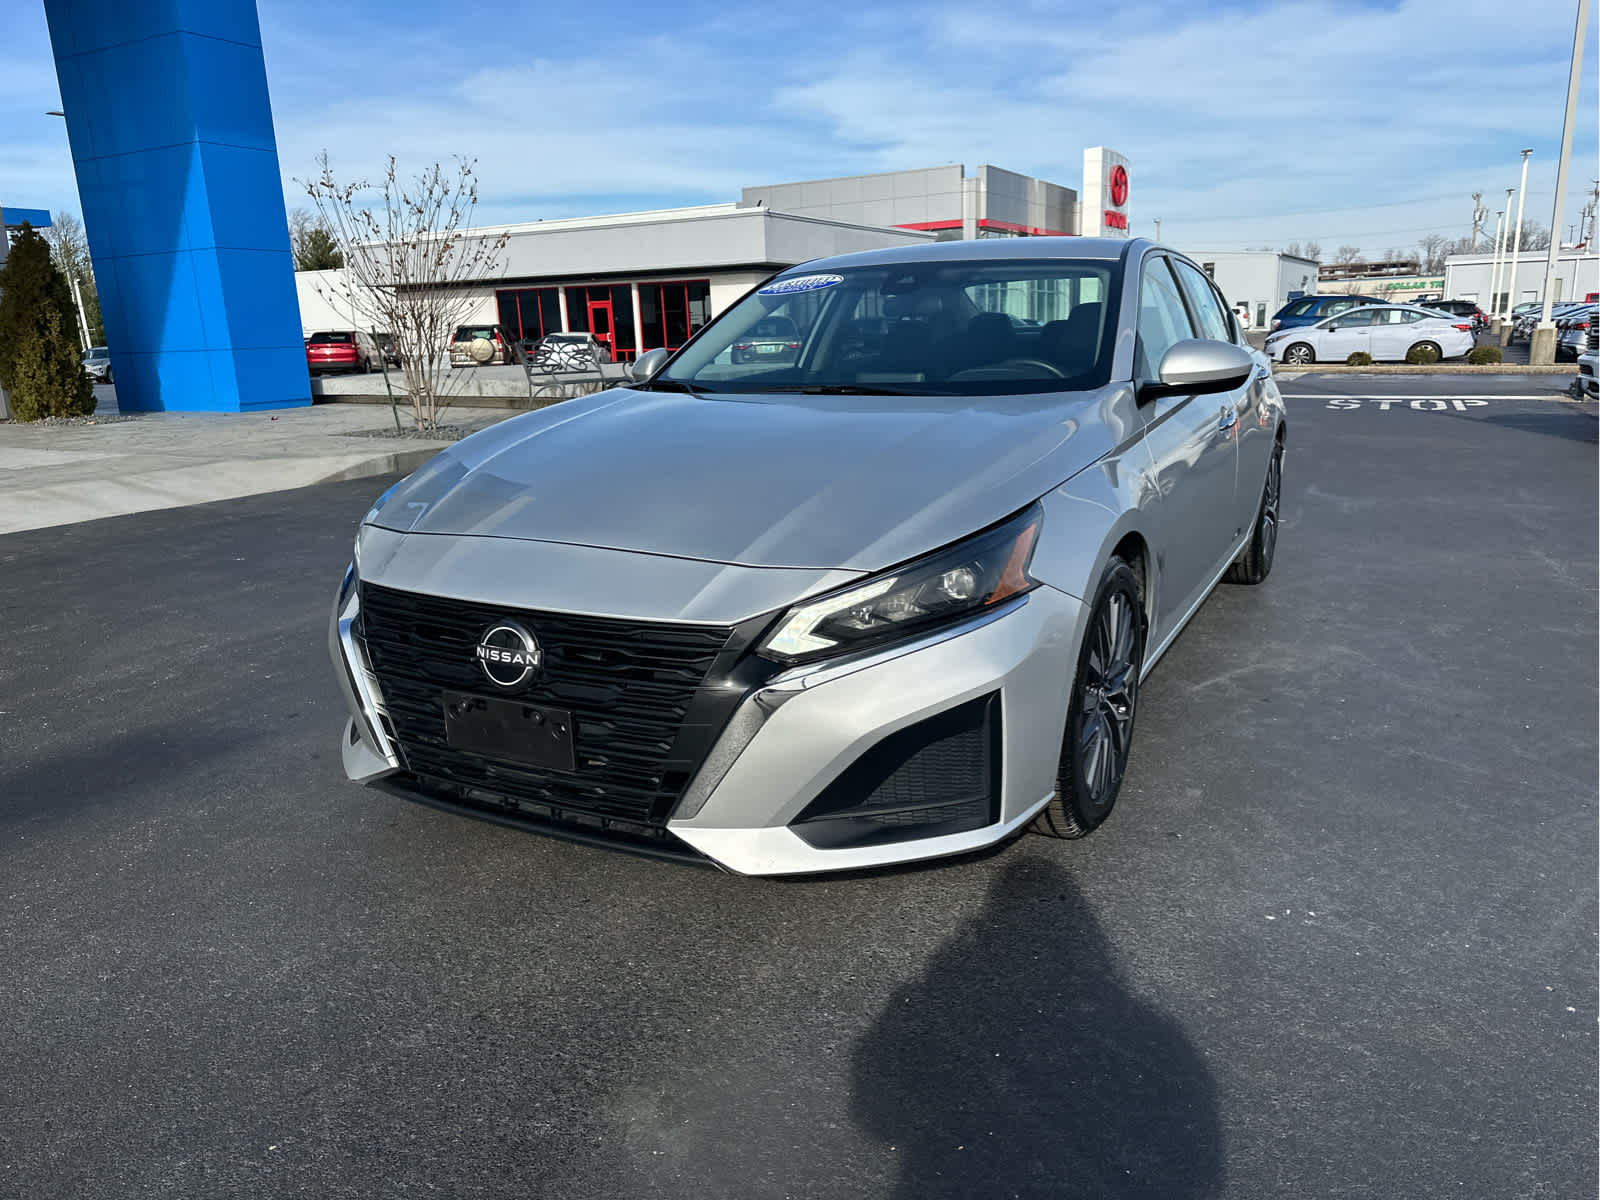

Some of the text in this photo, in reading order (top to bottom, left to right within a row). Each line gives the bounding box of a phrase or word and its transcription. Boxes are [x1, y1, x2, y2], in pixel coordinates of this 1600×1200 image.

[1388, 281, 1426, 290] DOLLAR
[1326, 399, 1489, 411] STOP
[476, 646, 538, 665] NISSAN
